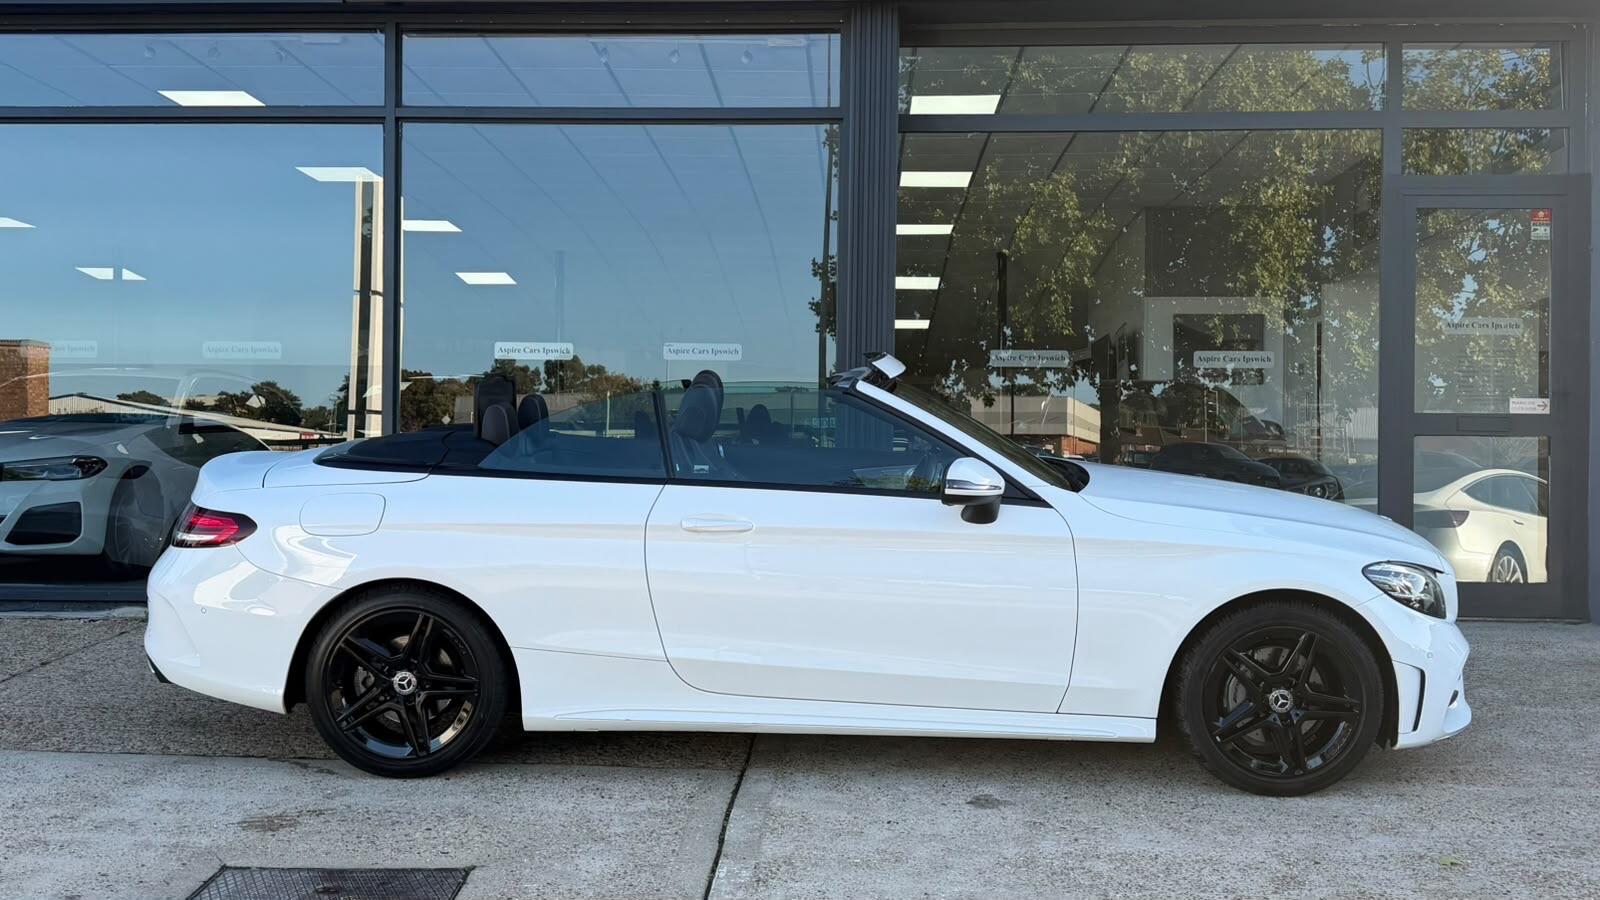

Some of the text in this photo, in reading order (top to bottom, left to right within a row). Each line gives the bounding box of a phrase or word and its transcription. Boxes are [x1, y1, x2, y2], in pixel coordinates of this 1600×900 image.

[1447, 321, 1520, 330] Aspire Cars Ipswich
[497, 346, 571, 356] Aspire Cars Ipswich
[668, 347, 739, 357] Aspire Cars Ipswich
[995, 354, 1017, 362] Aspire
[1038, 354, 1066, 362] Ipswich
[1198, 354, 1272, 363] Aspire Cars Ipswich
